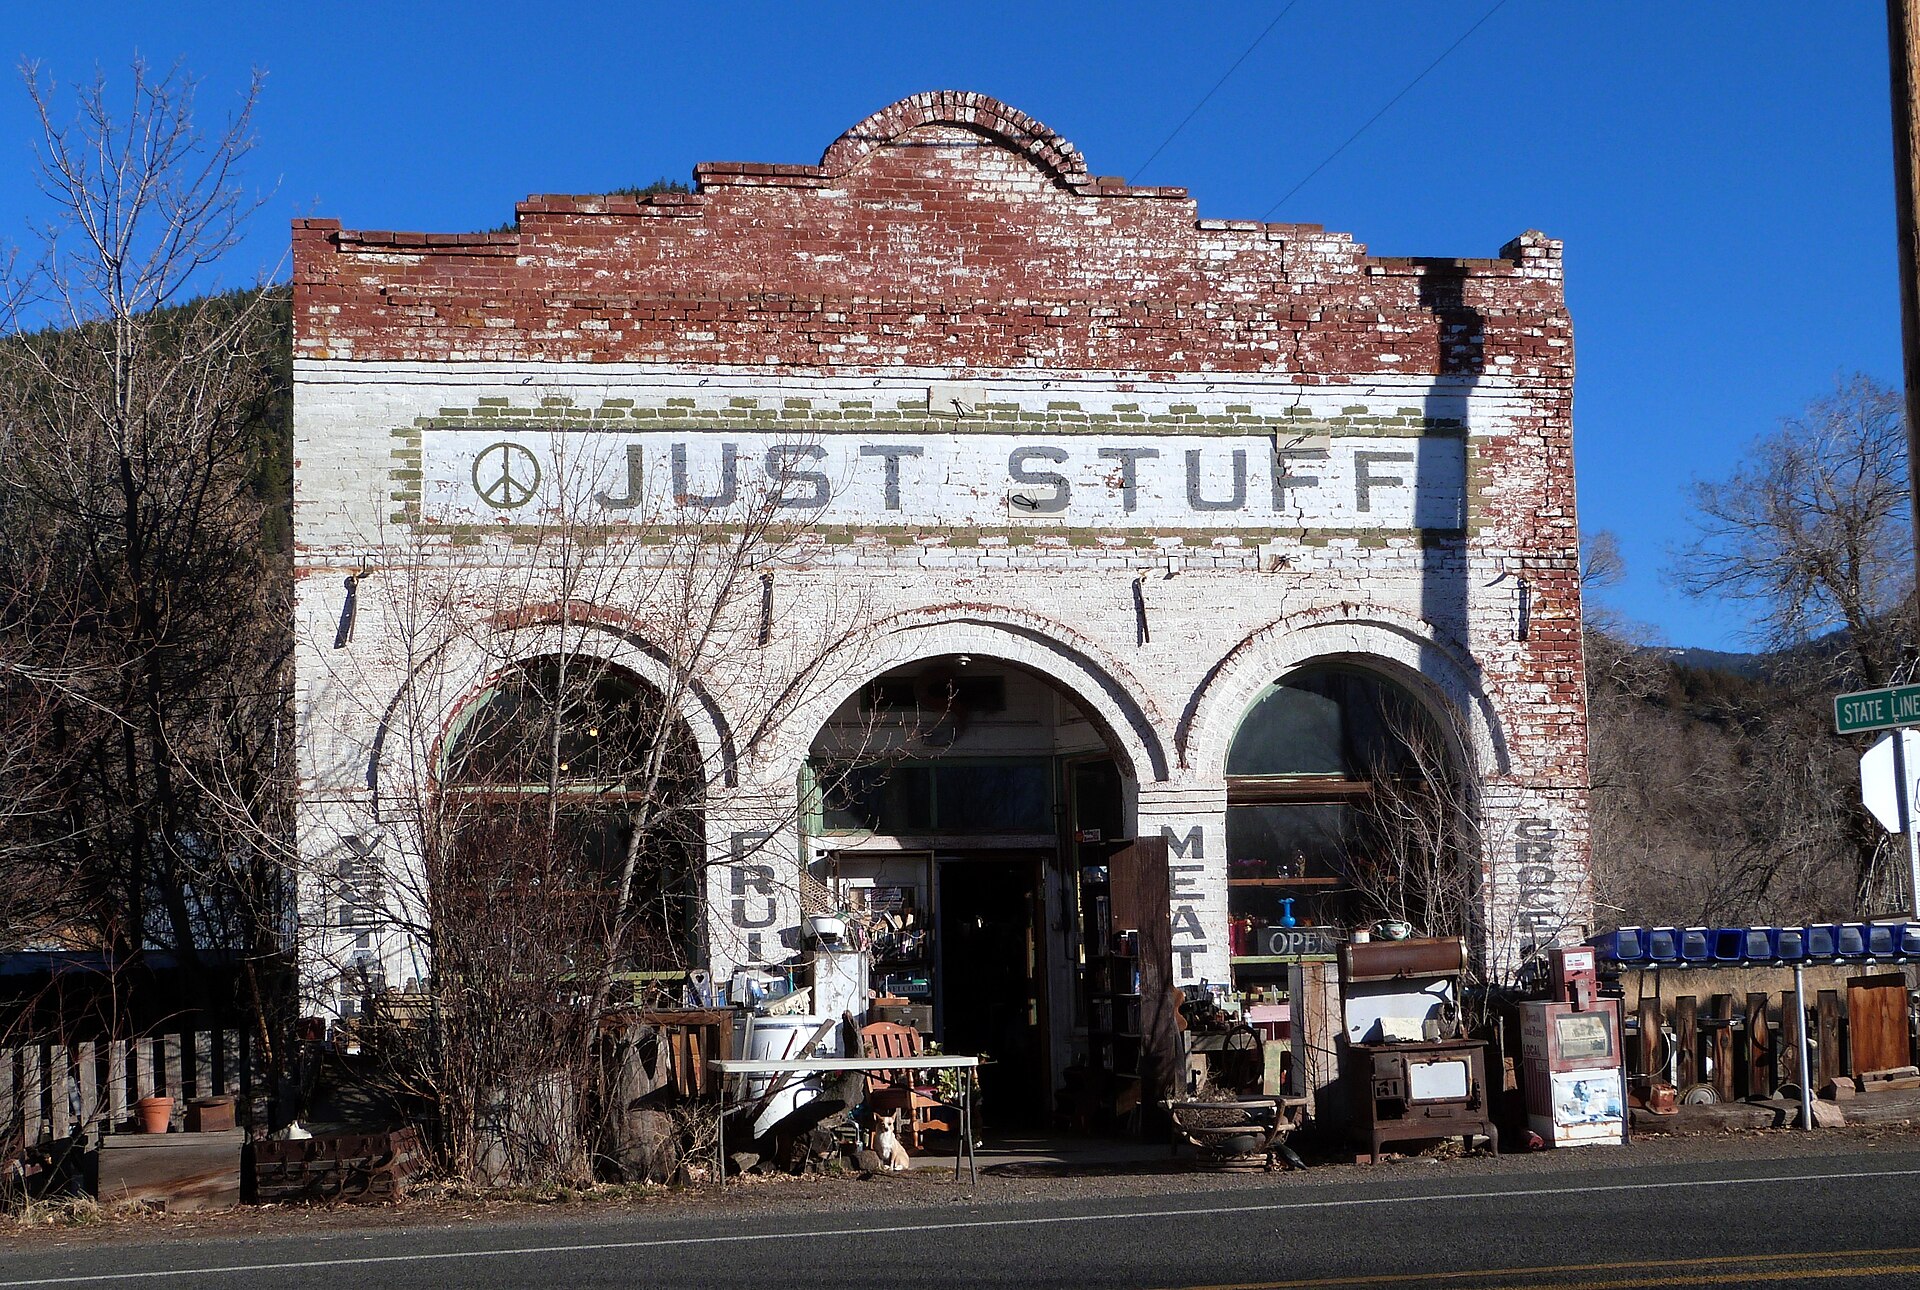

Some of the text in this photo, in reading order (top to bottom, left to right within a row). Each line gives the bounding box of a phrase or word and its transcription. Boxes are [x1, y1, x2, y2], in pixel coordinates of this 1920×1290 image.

[592, 442, 1415, 513] JUST STUFF
[1844, 694, 1920, 724] STATE LINE
[1160, 825, 1208, 979] MEAT
